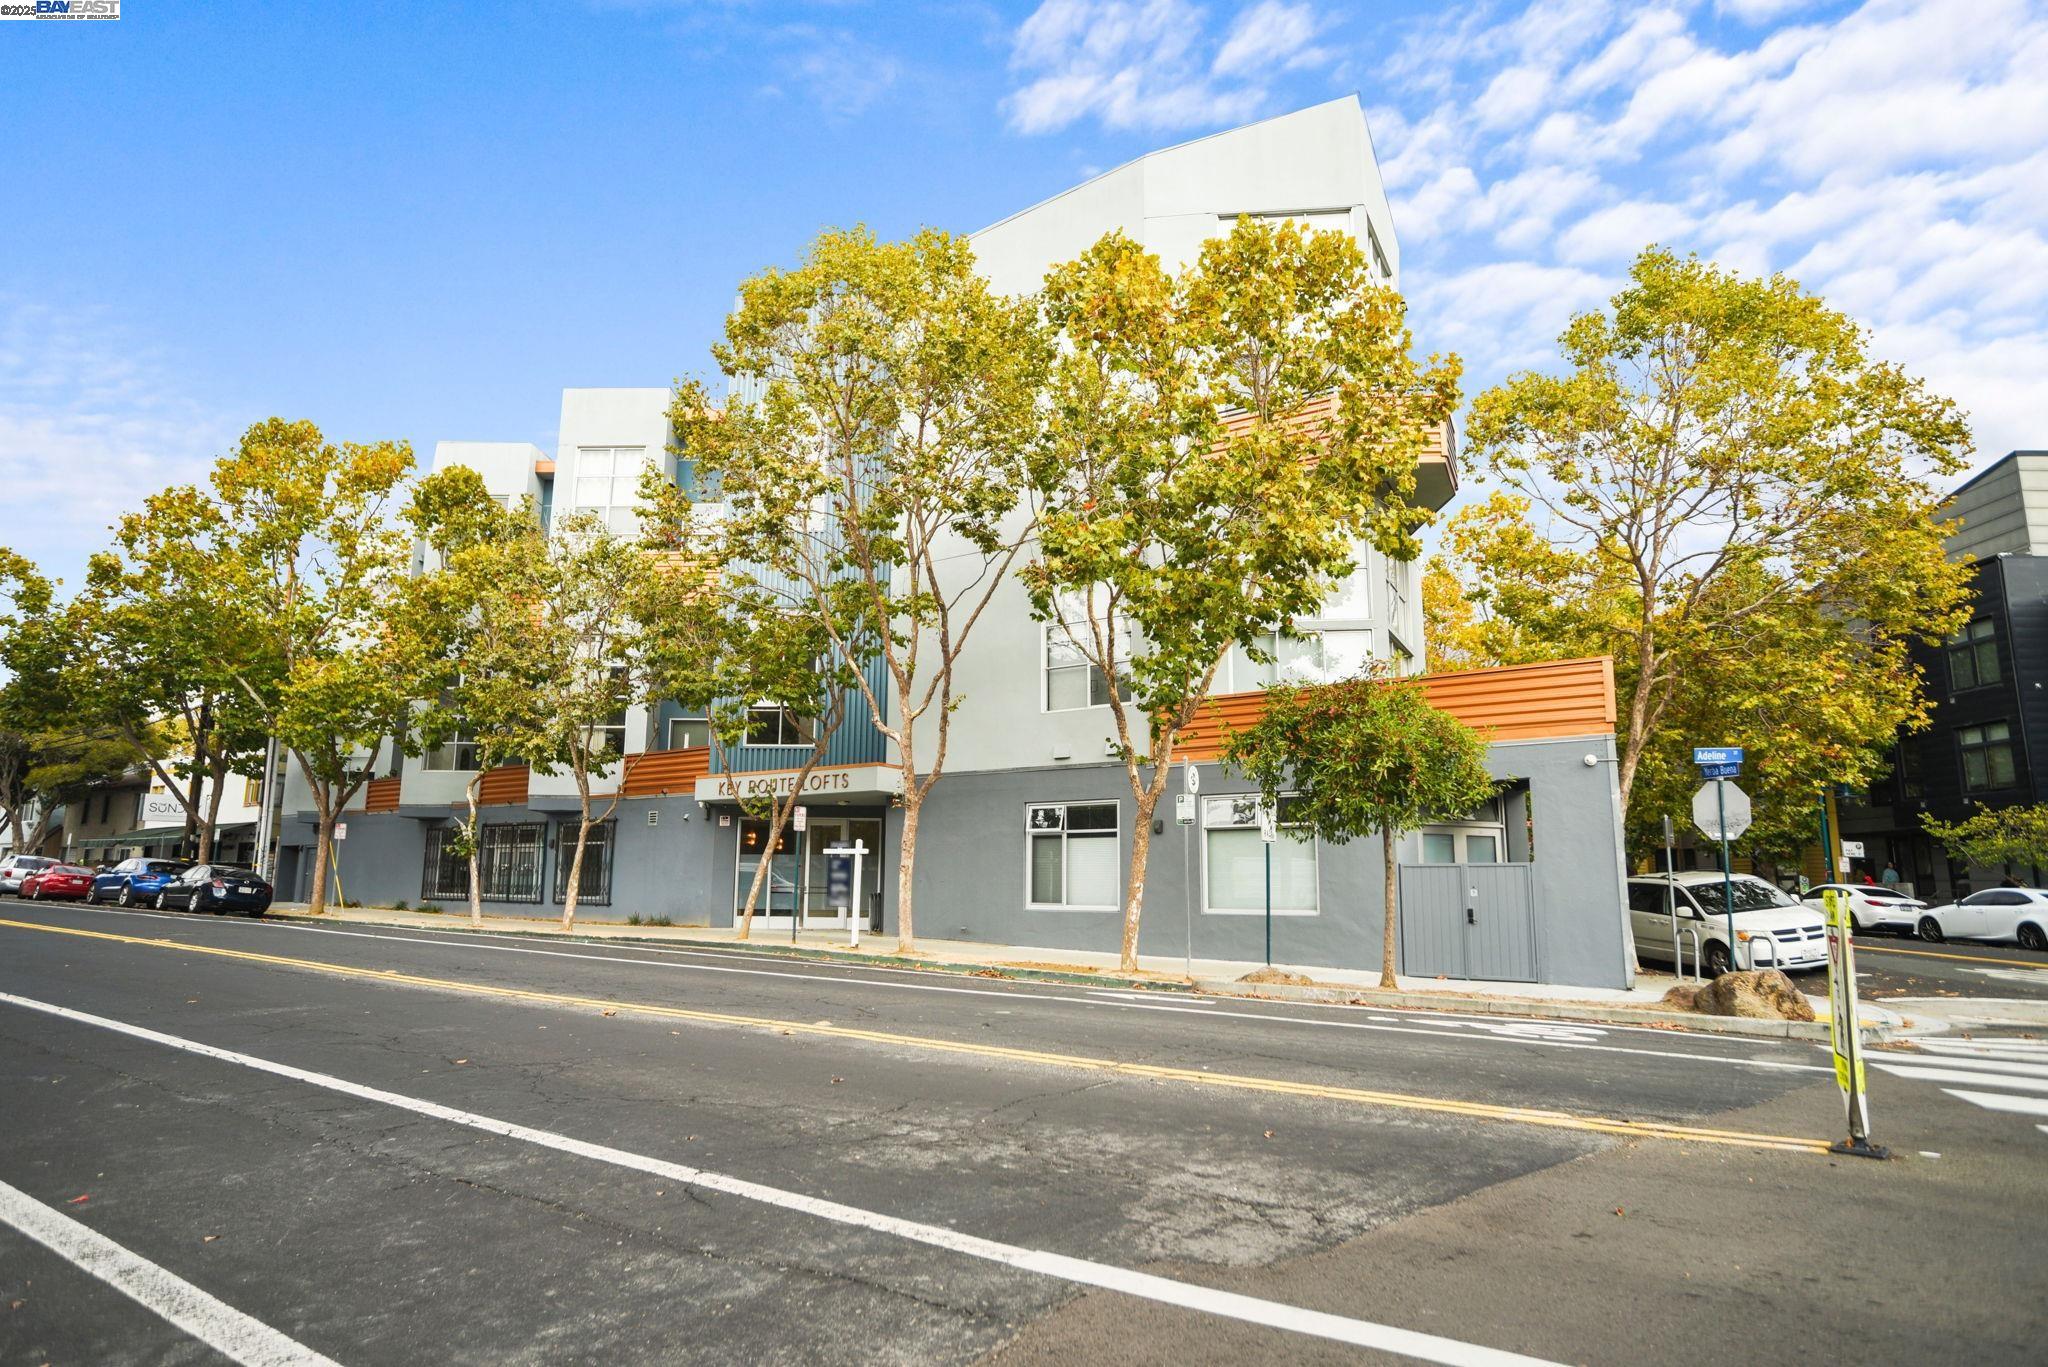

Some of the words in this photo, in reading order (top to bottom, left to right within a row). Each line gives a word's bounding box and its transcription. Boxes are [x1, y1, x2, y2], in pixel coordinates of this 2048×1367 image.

[1697, 751, 1727, 760] Adeline
[1704, 766, 1719, 776] Yerba
[1720, 765, 1737, 775] Buena
[718, 780, 742, 796] KEY
[748, 777, 795, 794] ROUTE
[802, 773, 849, 791] LOFTS
